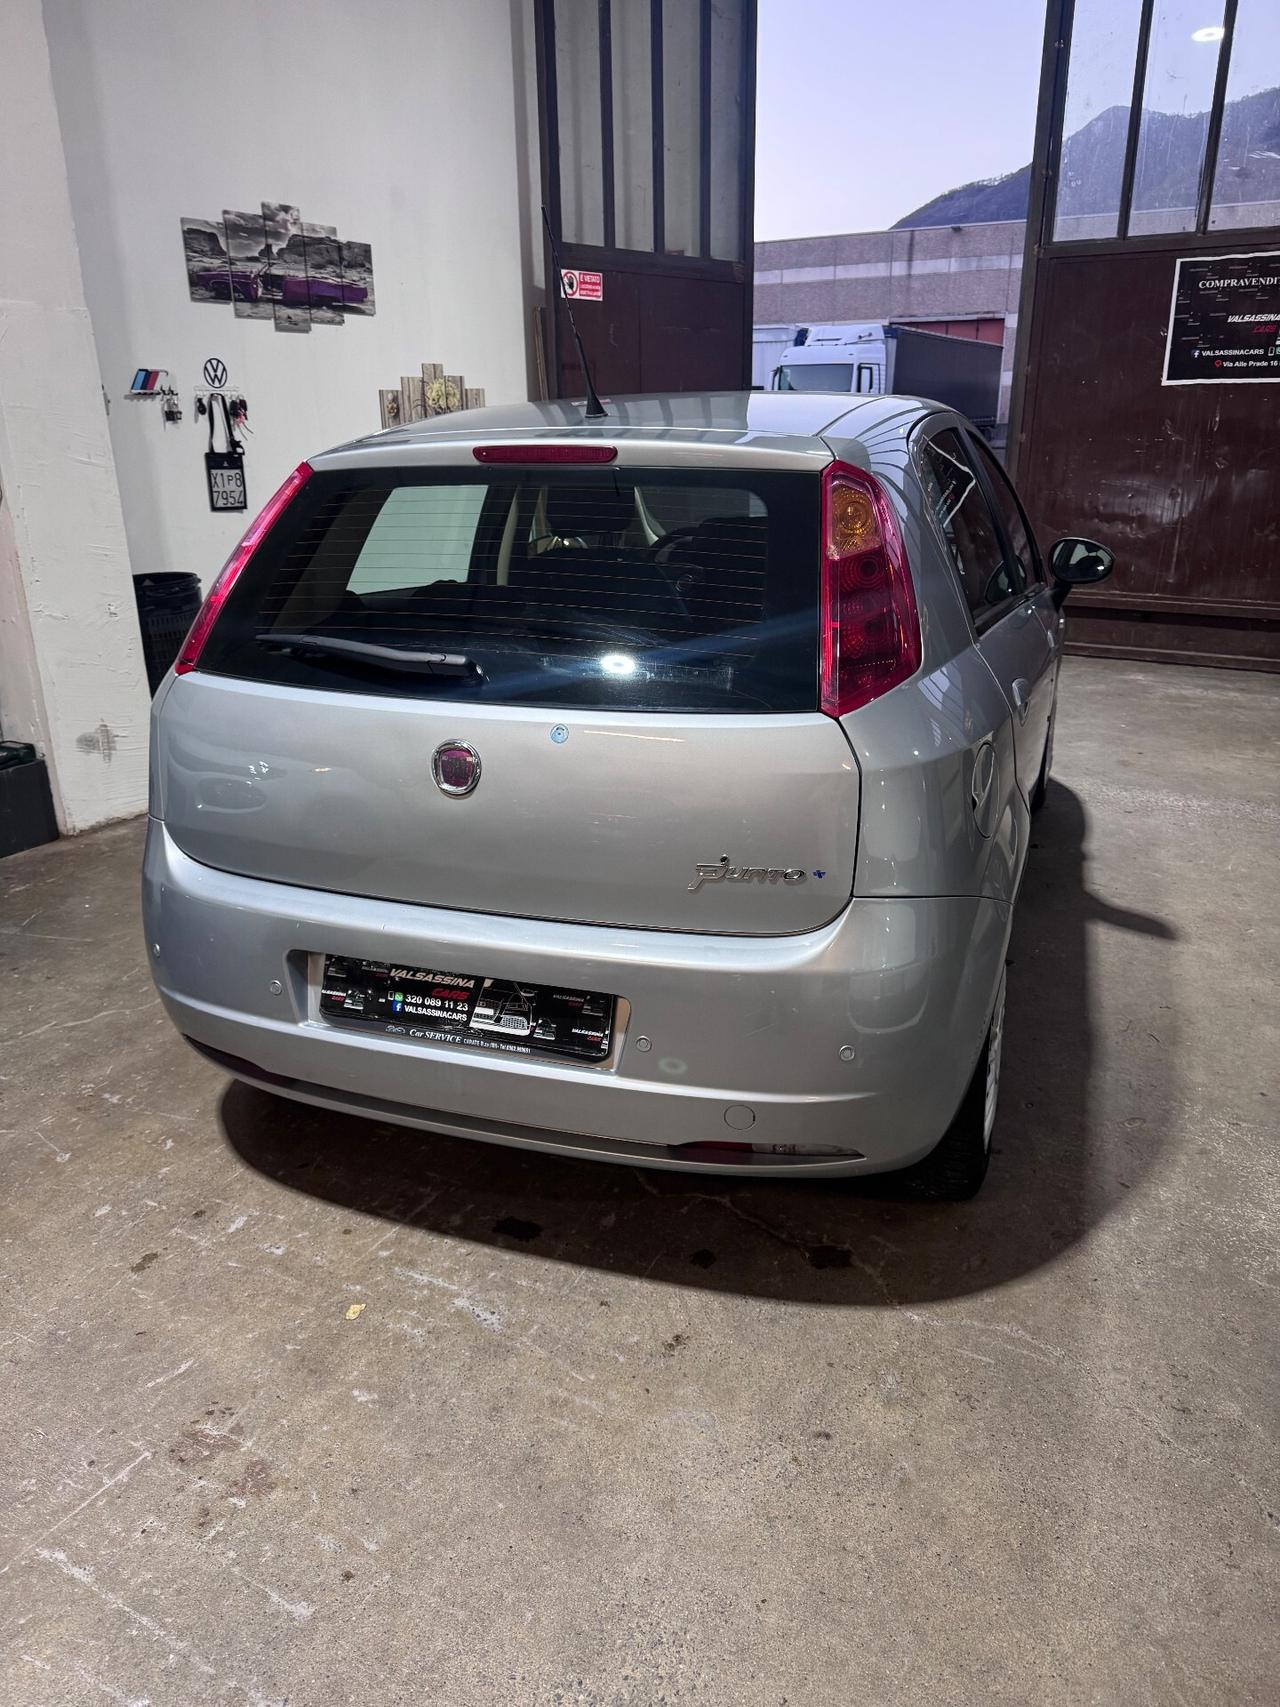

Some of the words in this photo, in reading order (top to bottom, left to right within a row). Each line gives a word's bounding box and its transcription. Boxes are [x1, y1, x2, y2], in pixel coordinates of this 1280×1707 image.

[1202, 349, 1264, 357] VALSASSINACARS
[213, 490, 243, 506] 7954
[390, 968, 475, 988] VALSASSINA
[432, 988, 470, 1000] CARS
[405, 994, 422, 1004] 320
[424, 997, 441, 1007] 089
[444, 1000, 454, 1009] 11
[456, 1002, 469, 1012] 23
[404, 1005, 468, 1021] VALSASSINACARS
[409, 1028, 424, 1038] Car
[424, 1031, 462, 1044] SERVICE
